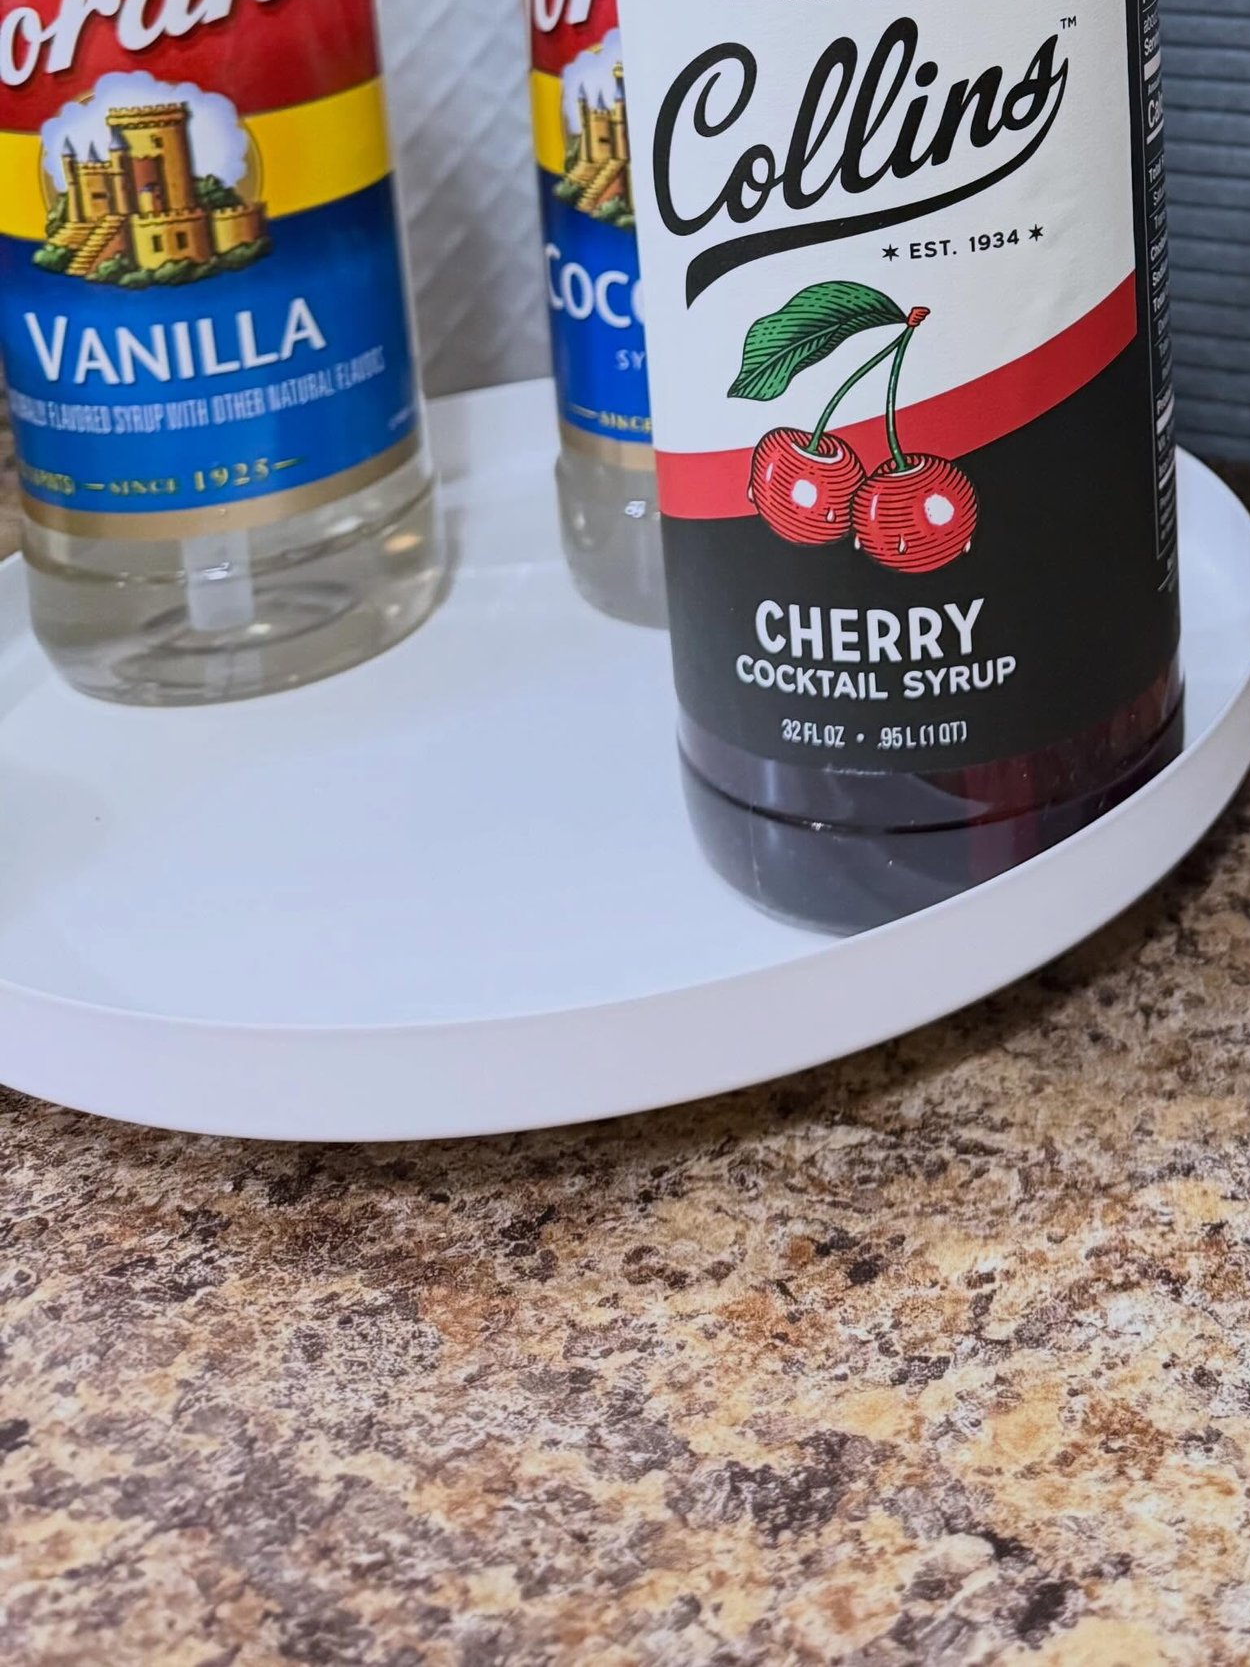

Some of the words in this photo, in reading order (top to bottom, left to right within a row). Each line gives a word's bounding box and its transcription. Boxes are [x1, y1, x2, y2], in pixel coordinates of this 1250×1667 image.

[651, 15, 1070, 242] Collins
[909, 239, 958, 260] EST.
[969, 231, 1020, 253] 1934
[23, 297, 328, 385] VANILLA
[165, 397, 210, 430] WITH
[211, 387, 266, 425] OTHER
[194, 457, 270, 492] 1925
[754, 598, 986, 664] CHERRY
[735, 654, 889, 701] COCKTAIL
[902, 655, 1017, 699] SYRUP
